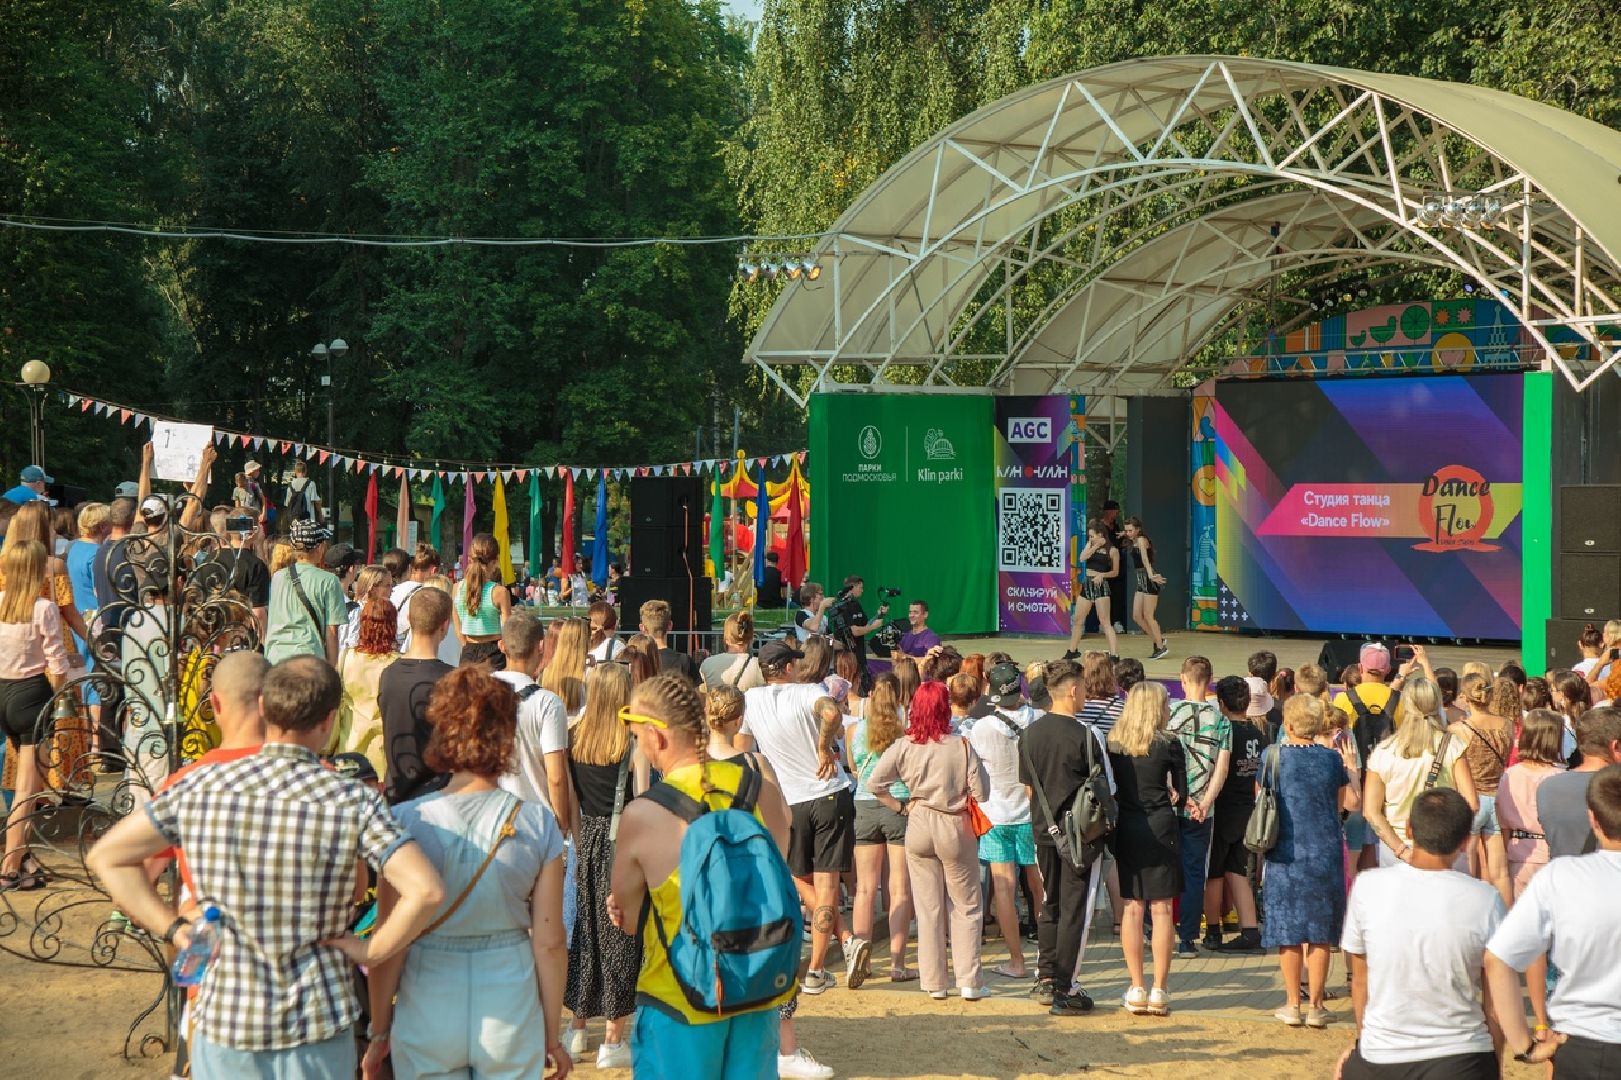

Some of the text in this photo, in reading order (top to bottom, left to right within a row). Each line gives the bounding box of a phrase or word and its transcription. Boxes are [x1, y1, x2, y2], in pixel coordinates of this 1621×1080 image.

[1010, 421, 1048, 439] AGC
[857, 463, 882, 473] ПАРКИ
[917, 467, 963, 483] Klin parki
[842, 472, 897, 482] ПОДМОСКОВЬЯ
[1422, 475, 1490, 497] Dance
[1303, 490, 1391, 508] Студия танца
[1017, 602, 1057, 613] СМОТРИ
